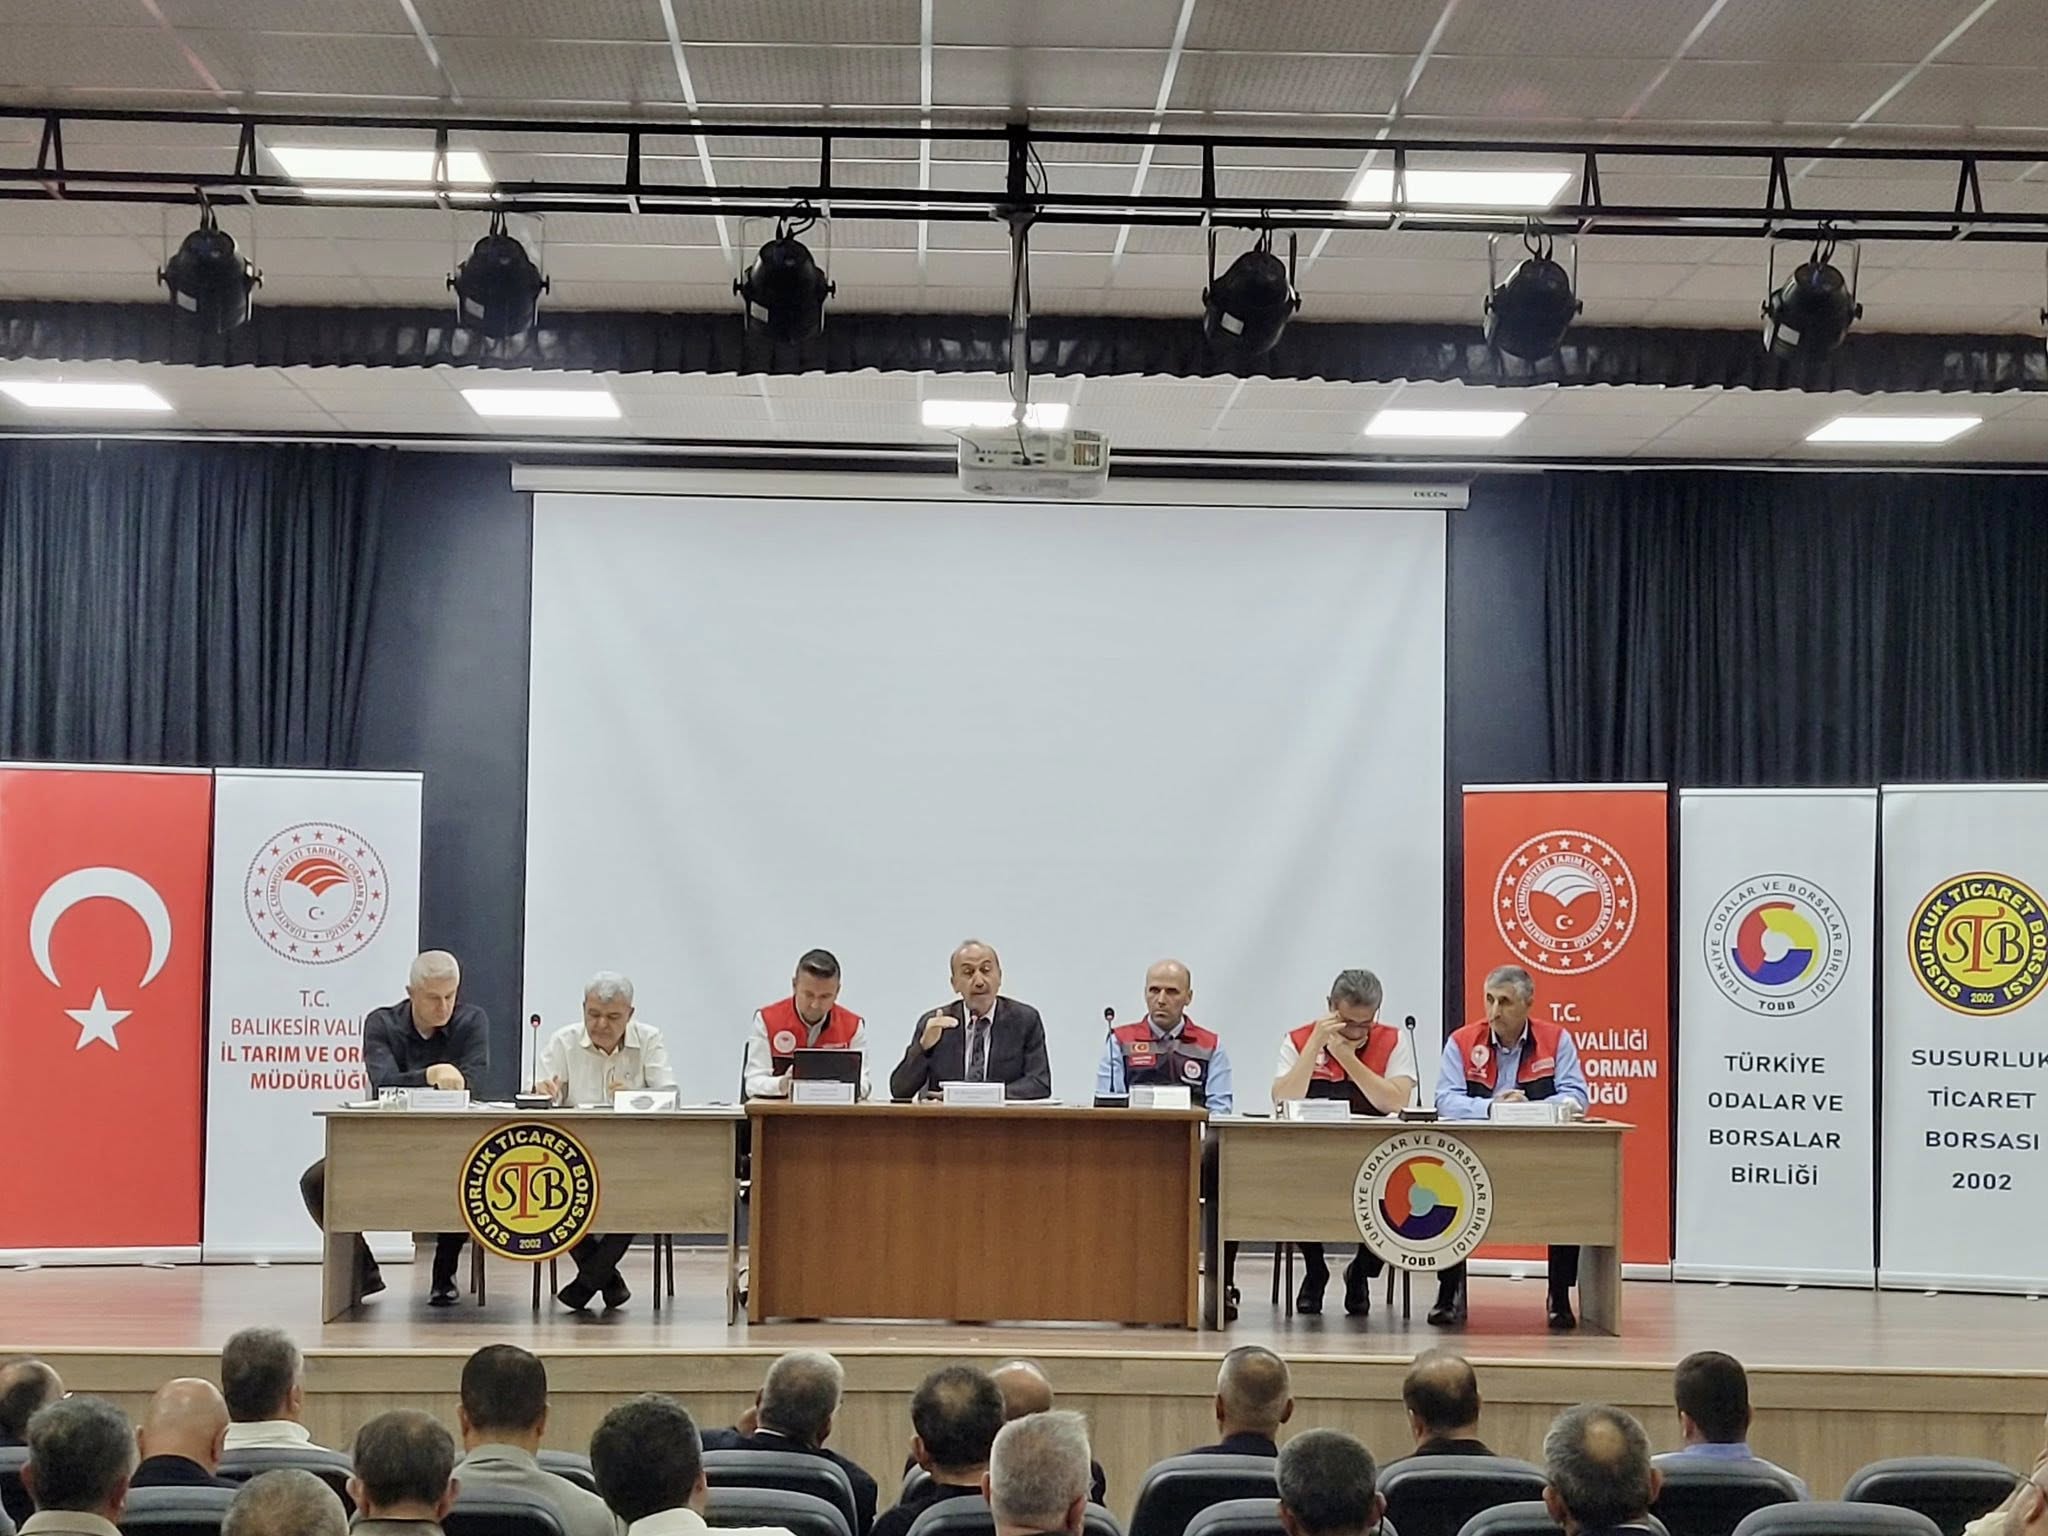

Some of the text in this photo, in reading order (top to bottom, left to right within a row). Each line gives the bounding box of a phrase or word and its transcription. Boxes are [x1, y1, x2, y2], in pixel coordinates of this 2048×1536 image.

[1714, 886, 1757, 932] ODALAR
[1762, 881, 1780, 891] VE
[1788, 882, 1842, 942] BORSALAR
[1919, 882, 2047, 1000] SUSURLUK TİCARET BORSASI
[299, 990, 330, 1007] T.C.
[1758, 1000, 1796, 1011] TOBB
[1970, 992, 1995, 1003] 2002
[1549, 1003, 1581, 1022] T.C.
[231, 1015, 362, 1036] BALIKESİR VALİ
[1575, 1028, 1648, 1051] VALİLİĞİ
[221, 1041, 365, 1063] İL TARIM VE OR
[1724, 1051, 1825, 1073] TÜRKİYE
[1911, 1049, 2048, 1068] SUSURLUK
[1585, 1059, 1657, 1078] ORMAN
[251, 1068, 366, 1090] MÜDÜRLÜĞ
[1588, 1082, 1628, 1104] ÜĞÜ
[1708, 1092, 1843, 1111] ODALAR VE
[1927, 1086, 2037, 1109] TİCARET
[1709, 1129, 1841, 1149] BORSALAR
[1926, 1131, 2039, 1150] BORSASI
[1363, 1137, 1408, 1181] ODALAR
[1413, 1135, 1431, 1145] VE
[1437, 1138, 1487, 1201] BORSALAR
[1731, 1162, 1818, 1185] BİRLİĞİ
[1952, 1172, 2012, 1191] 2002
[468, 1149, 510, 1246] SUSURLUK
[549, 1164, 589, 1244] BORSASI
[518, 1238, 542, 1249] 2002
[1400, 1254, 1436, 1267] TOBB
